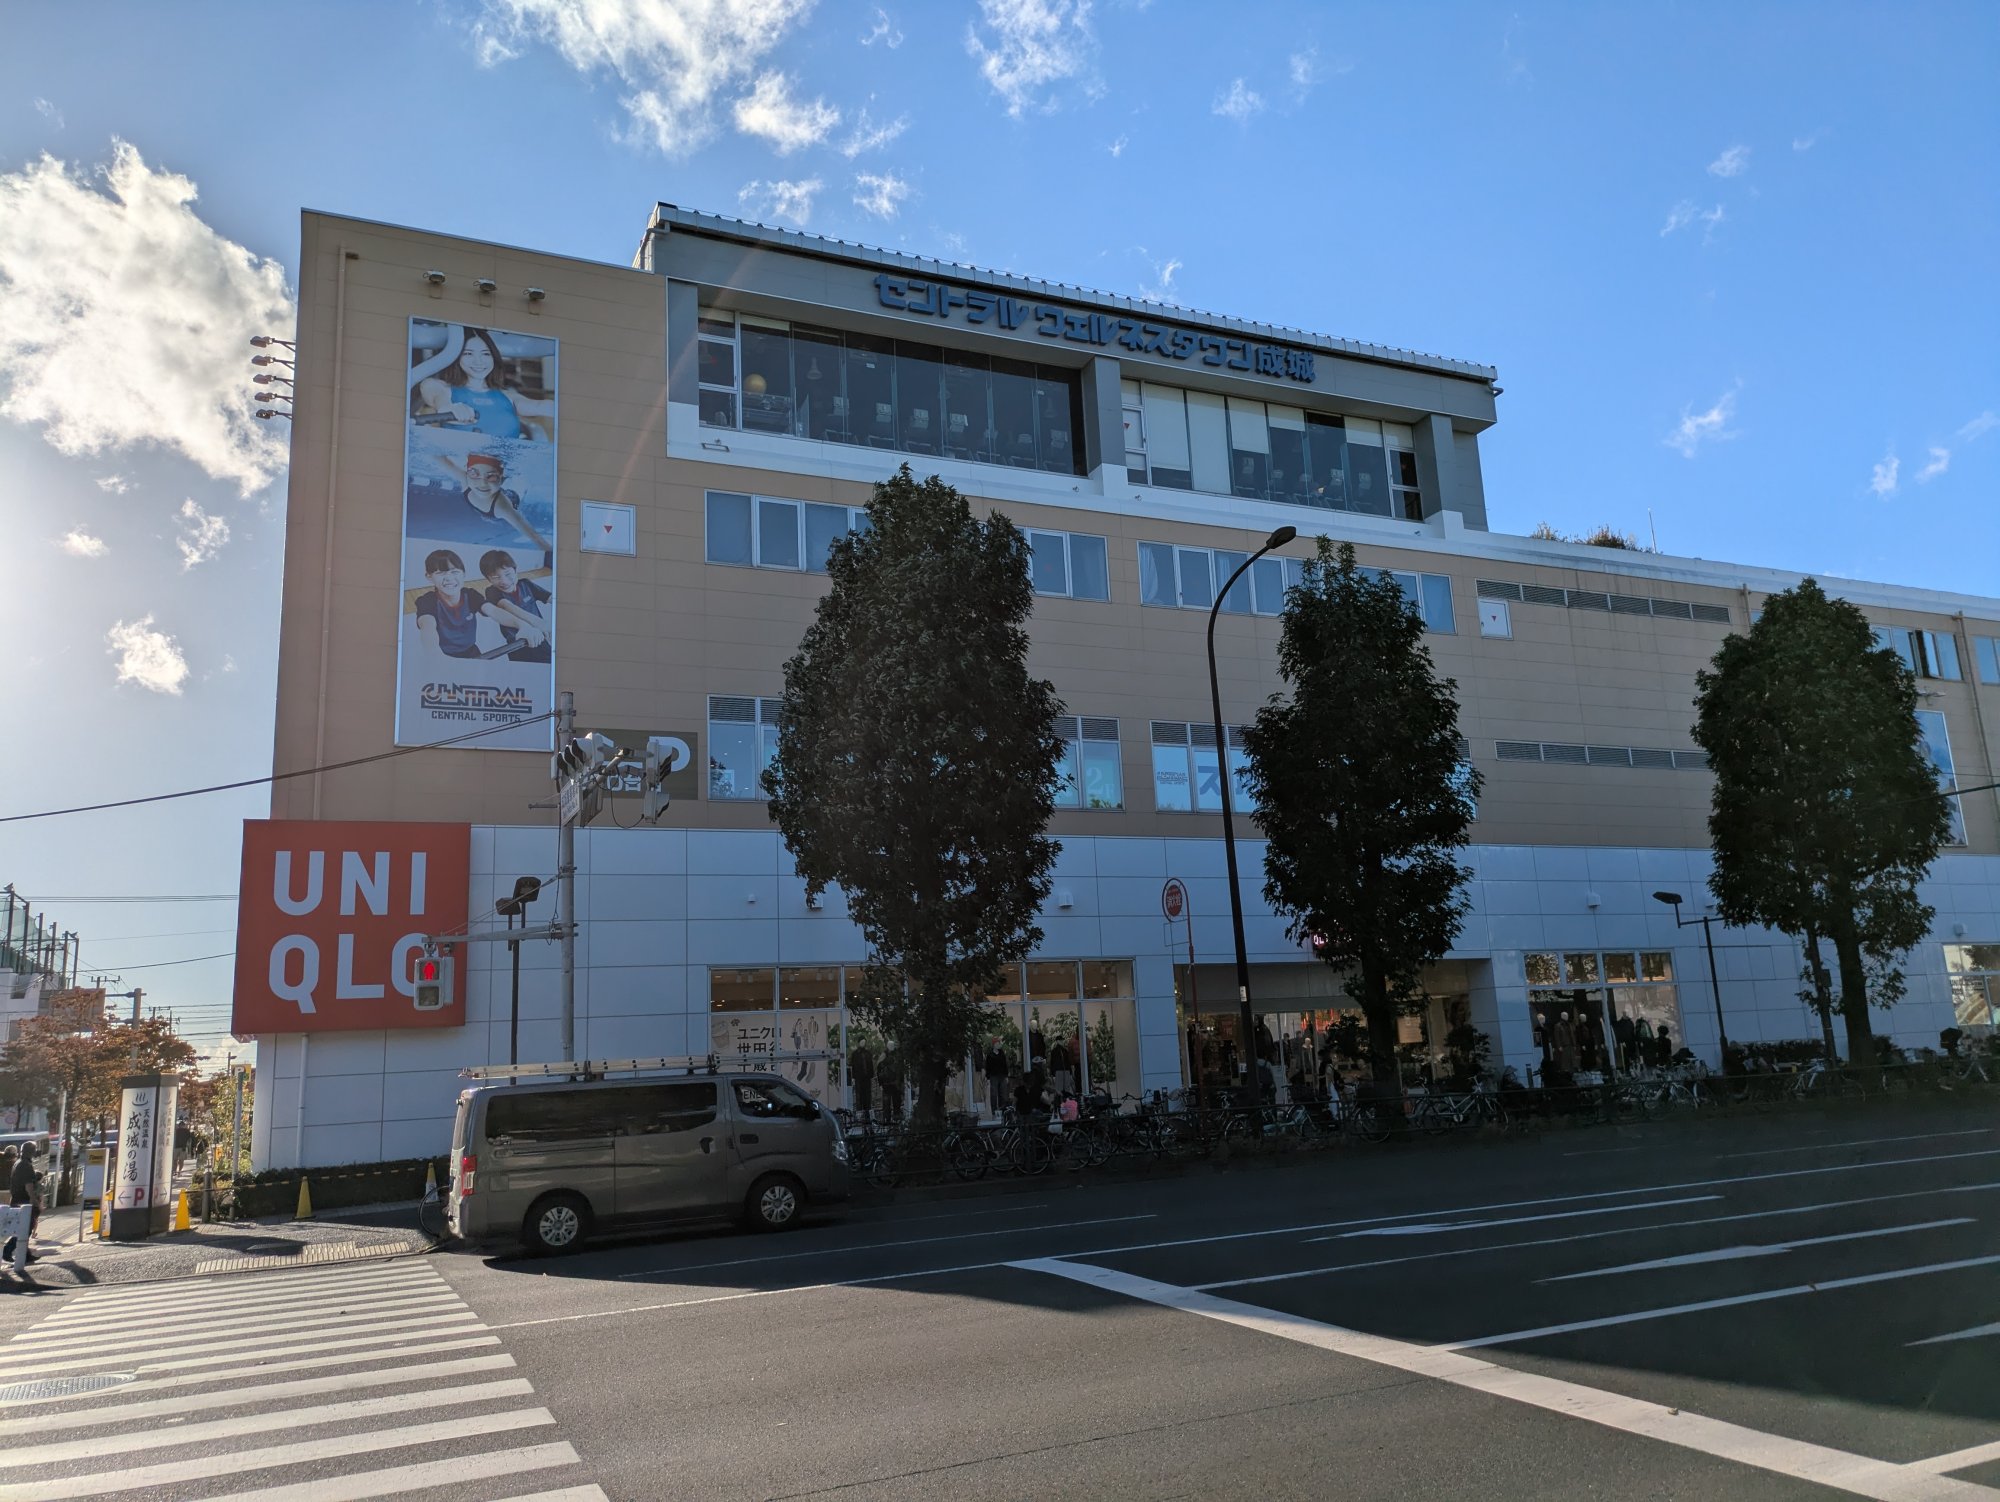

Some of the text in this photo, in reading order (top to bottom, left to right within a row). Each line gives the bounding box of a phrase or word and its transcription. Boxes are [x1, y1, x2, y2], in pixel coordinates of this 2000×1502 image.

[431, 710, 521, 723] CENTRAL SPORTS
[273, 851, 427, 916] UNI
[123, 1111, 142, 1182] 成城の湯
[141, 1108, 150, 1149] 天然温泉
[133, 1187, 145, 1206] P
